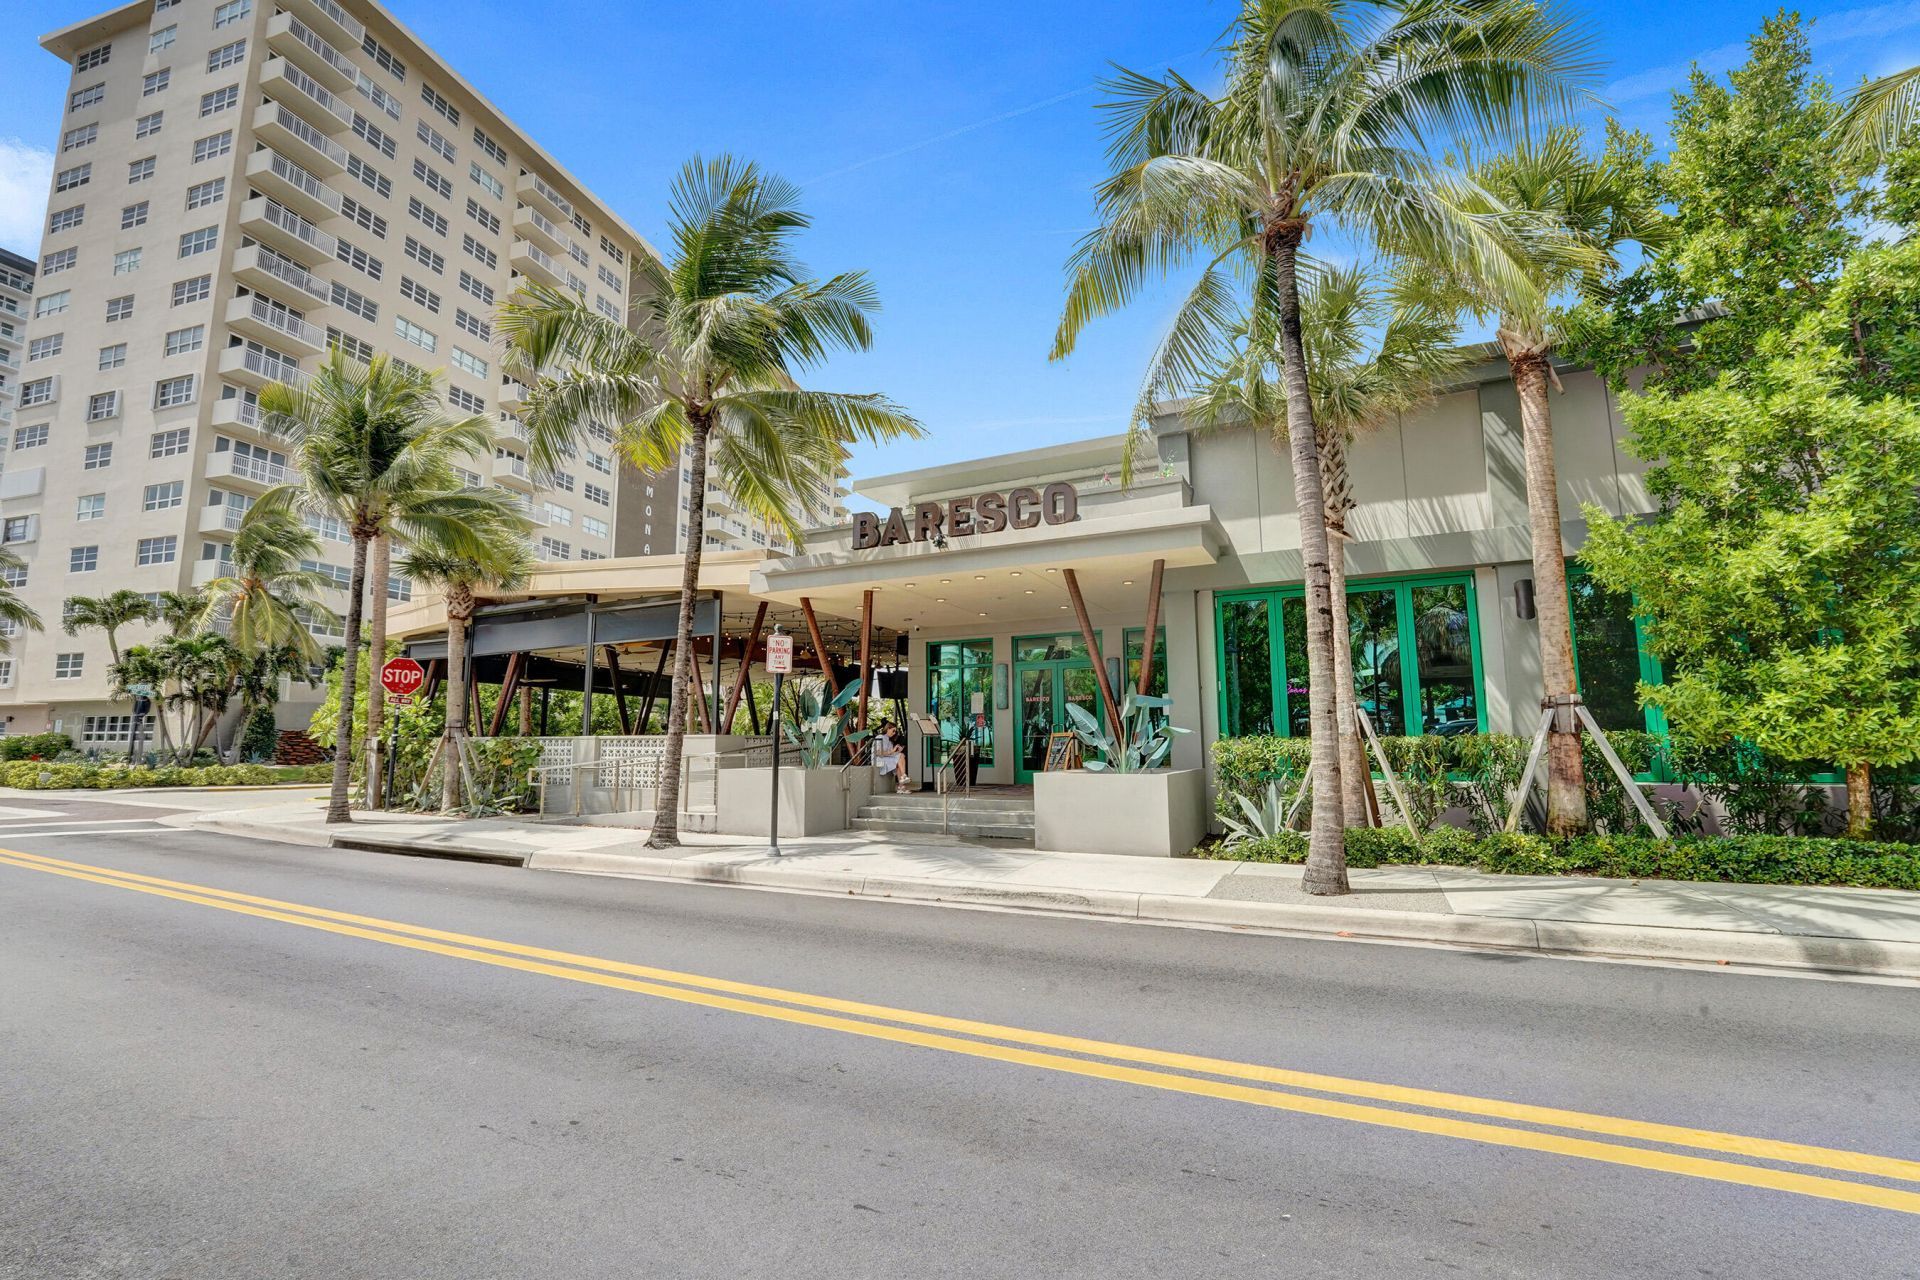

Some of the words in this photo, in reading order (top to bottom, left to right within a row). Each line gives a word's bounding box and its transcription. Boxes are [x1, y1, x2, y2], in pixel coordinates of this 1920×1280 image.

[851, 481, 1077, 550] BARESCO
[775, 639, 785, 647] NO
[768, 647, 791, 655] PARKING
[383, 668, 421, 684] STOP
